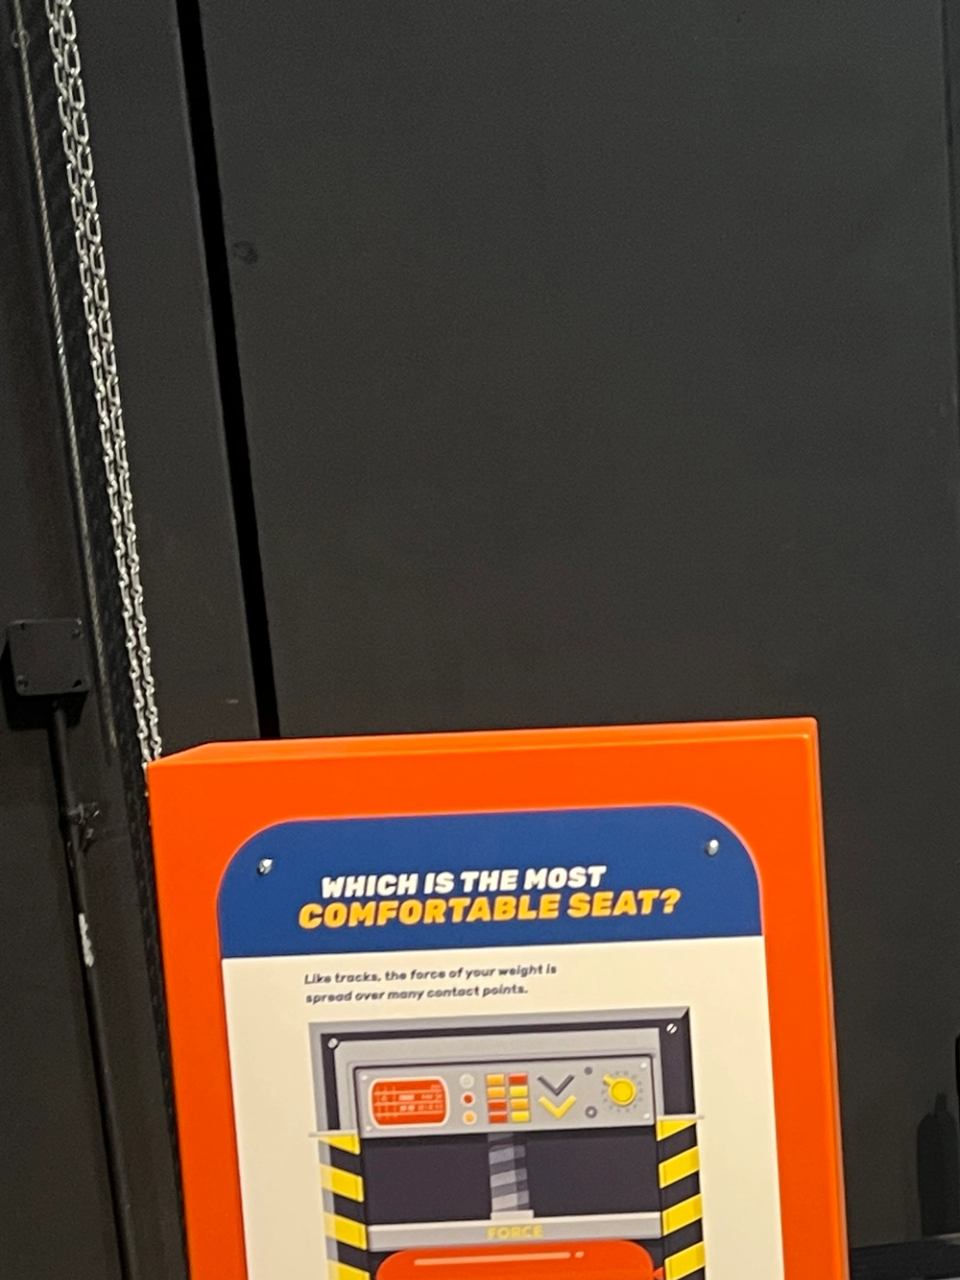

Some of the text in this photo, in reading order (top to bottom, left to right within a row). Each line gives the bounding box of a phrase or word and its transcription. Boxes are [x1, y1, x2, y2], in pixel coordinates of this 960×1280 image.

[321, 865, 607, 898] WHICH IS THE MOST
[298, 888, 682, 929] COMFORTABLE SEAT?
[304, 963, 557, 985] Like tracks, the force of your weight is
[306, 984, 528, 1004] spread over many contact points.
[486, 1225, 544, 1240] FORCE
